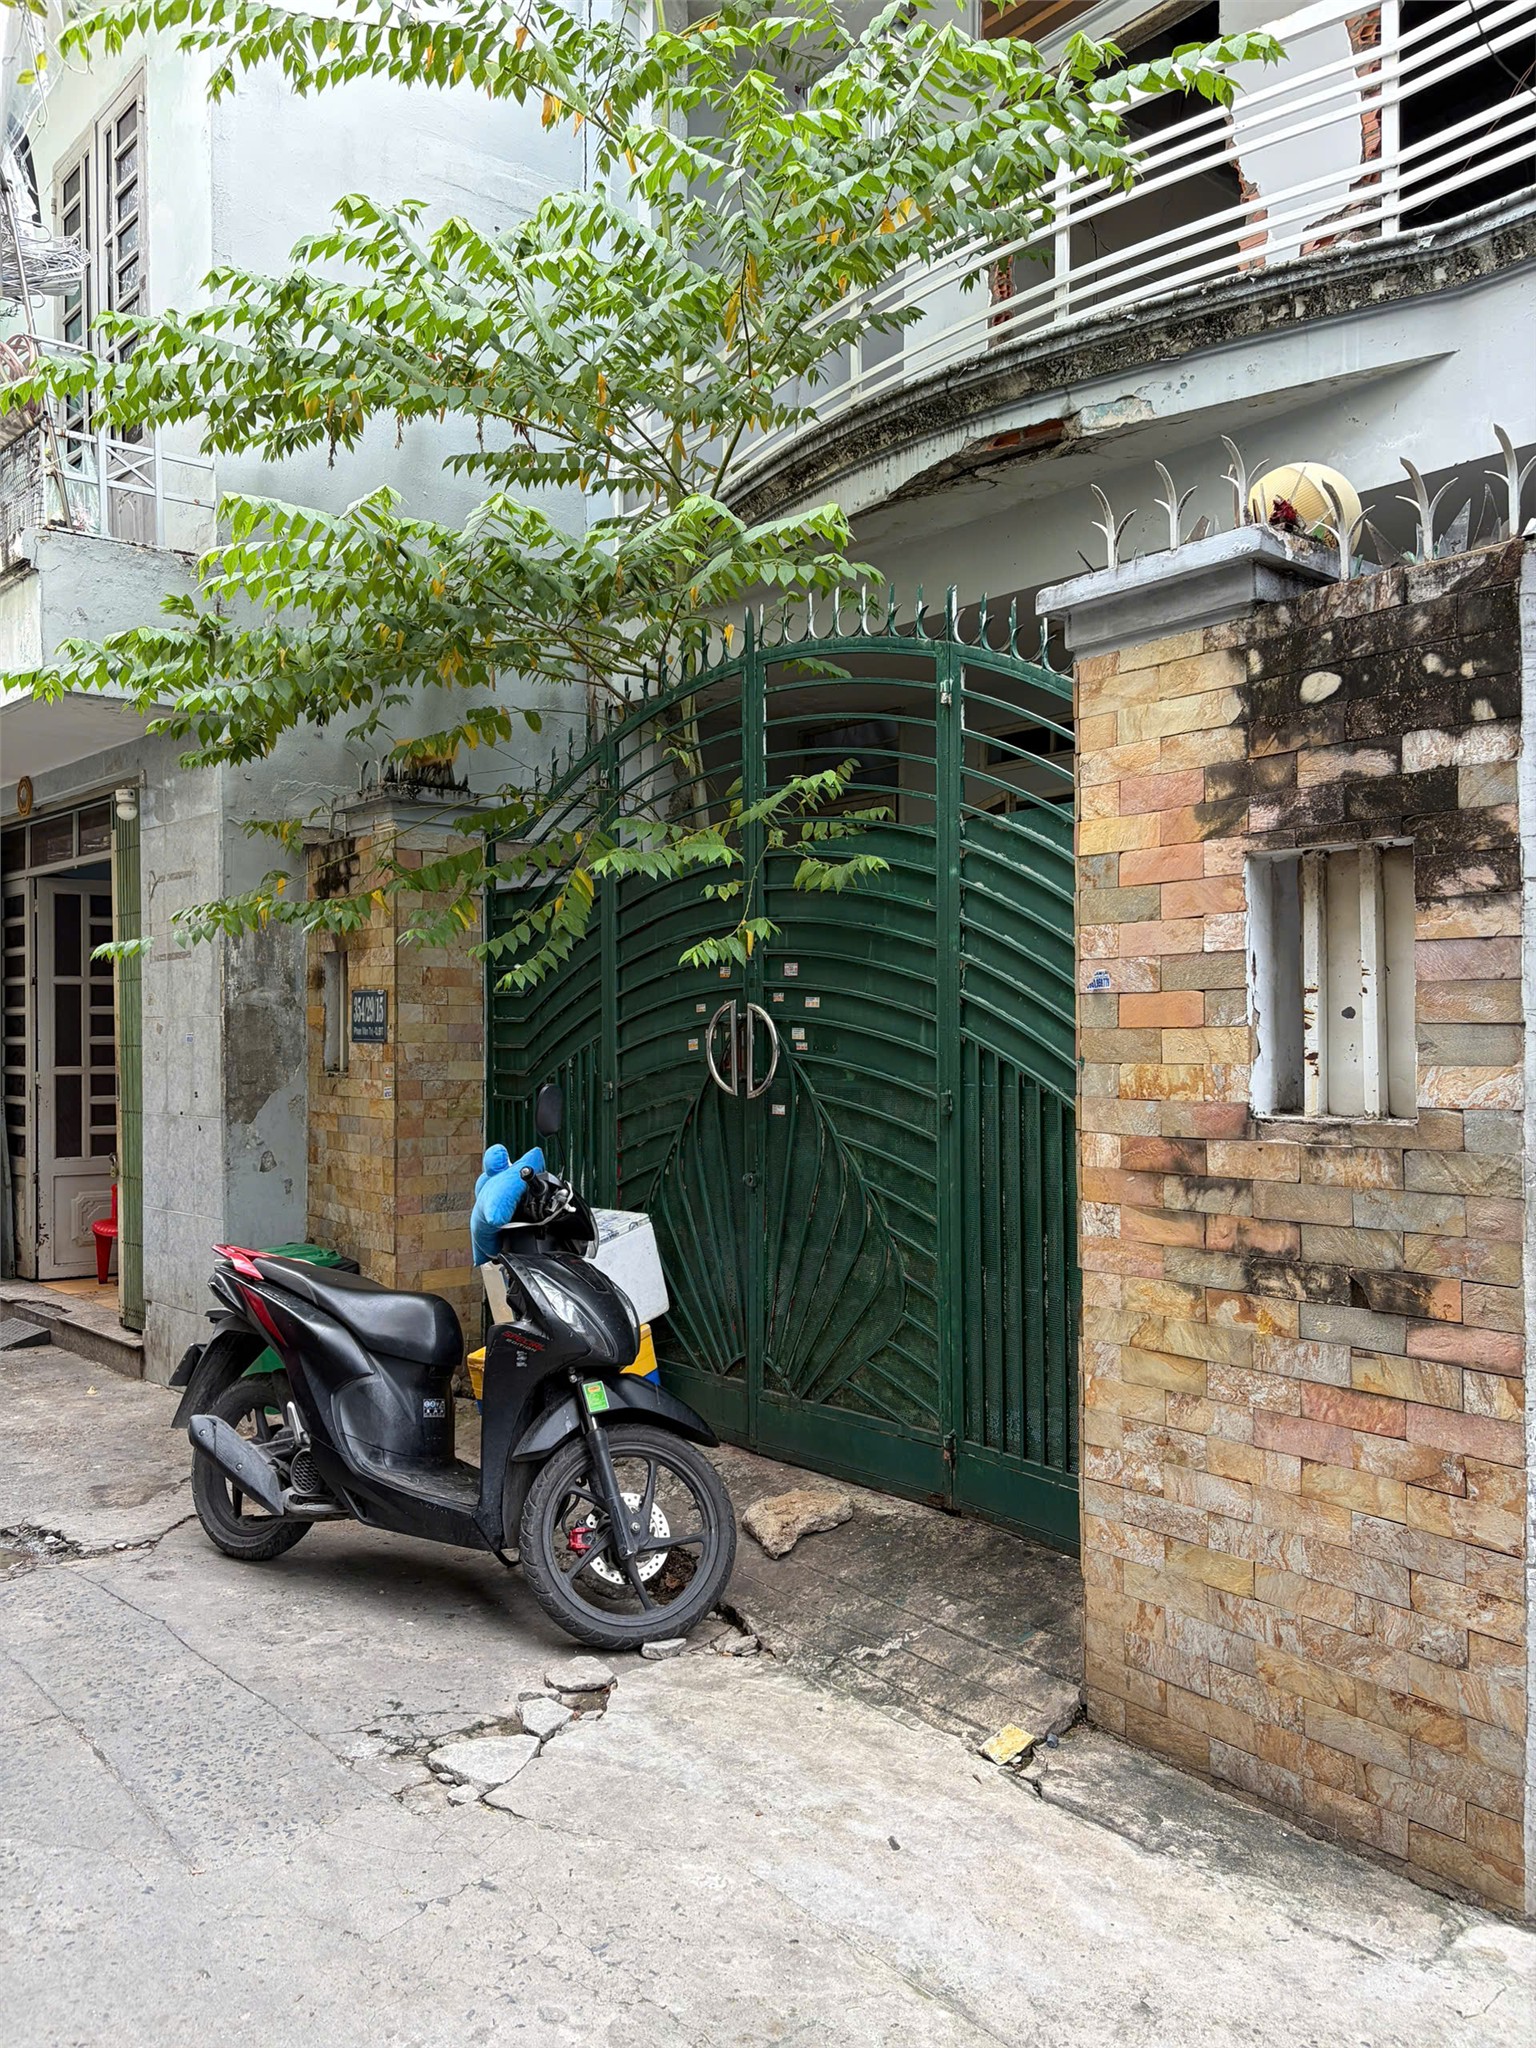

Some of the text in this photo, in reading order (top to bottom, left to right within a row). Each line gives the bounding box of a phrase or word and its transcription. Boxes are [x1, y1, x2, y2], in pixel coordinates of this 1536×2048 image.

[353, 996, 384, 1023] 354/29/15
[502, 1331, 545, 1351] SPECIAL
[505, 1338, 537, 1353] EDITION
